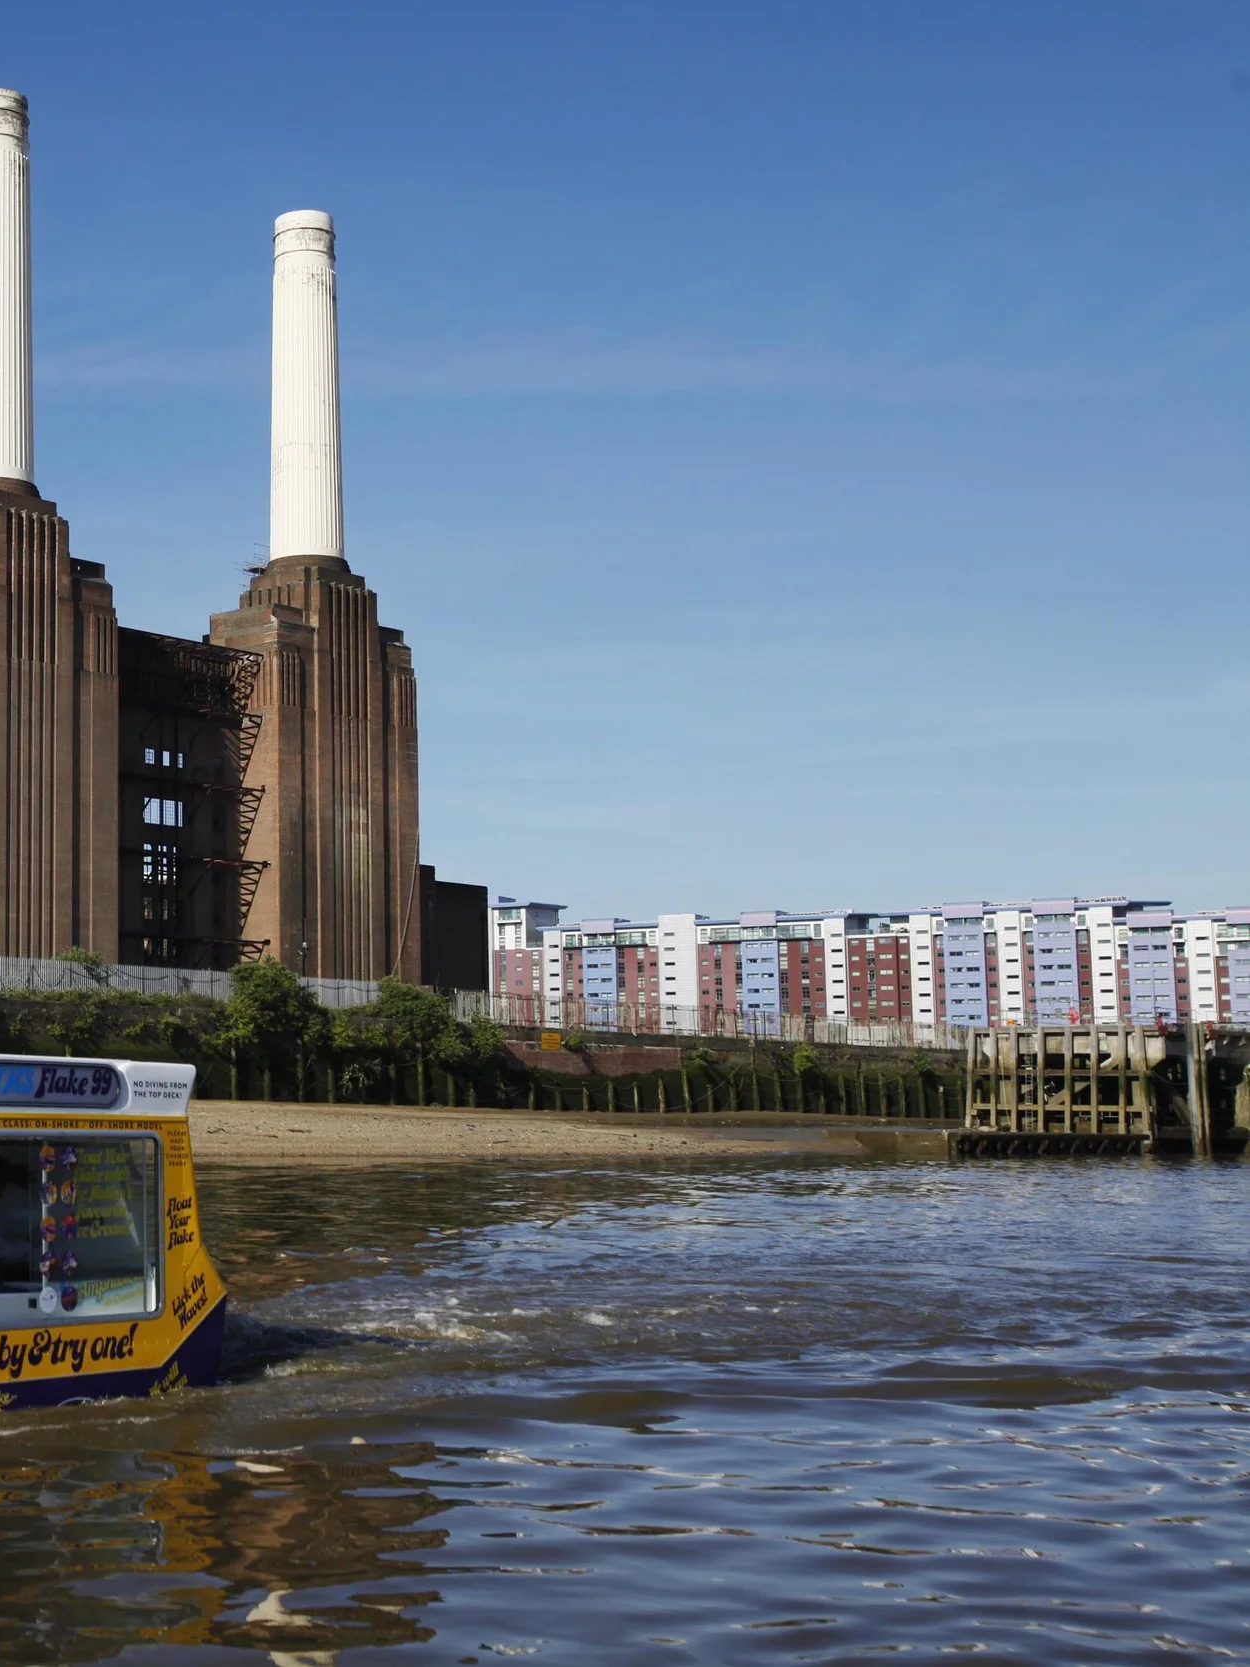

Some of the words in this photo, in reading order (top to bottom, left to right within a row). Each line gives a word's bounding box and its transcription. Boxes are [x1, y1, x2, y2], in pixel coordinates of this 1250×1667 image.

[34, 1068, 89, 1099] Flake
[91, 1067, 112, 1097] 99
[145, 1081, 168, 1089] DIVING
[170, 1081, 188, 1089] FROM
[149, 1091, 161, 1099] TOP
[137, 1121, 163, 1130] MODEL
[167, 1197, 192, 1216] Float
[169, 1214, 190, 1230] Your
[167, 1229, 194, 1251] Flake
[172, 1288, 191, 1316] Lick
[191, 1272, 205, 1293] the
[177, 1286, 208, 1330] Waves!
[51, 1332, 87, 1372] try
[91, 1323, 139, 1361] one!
